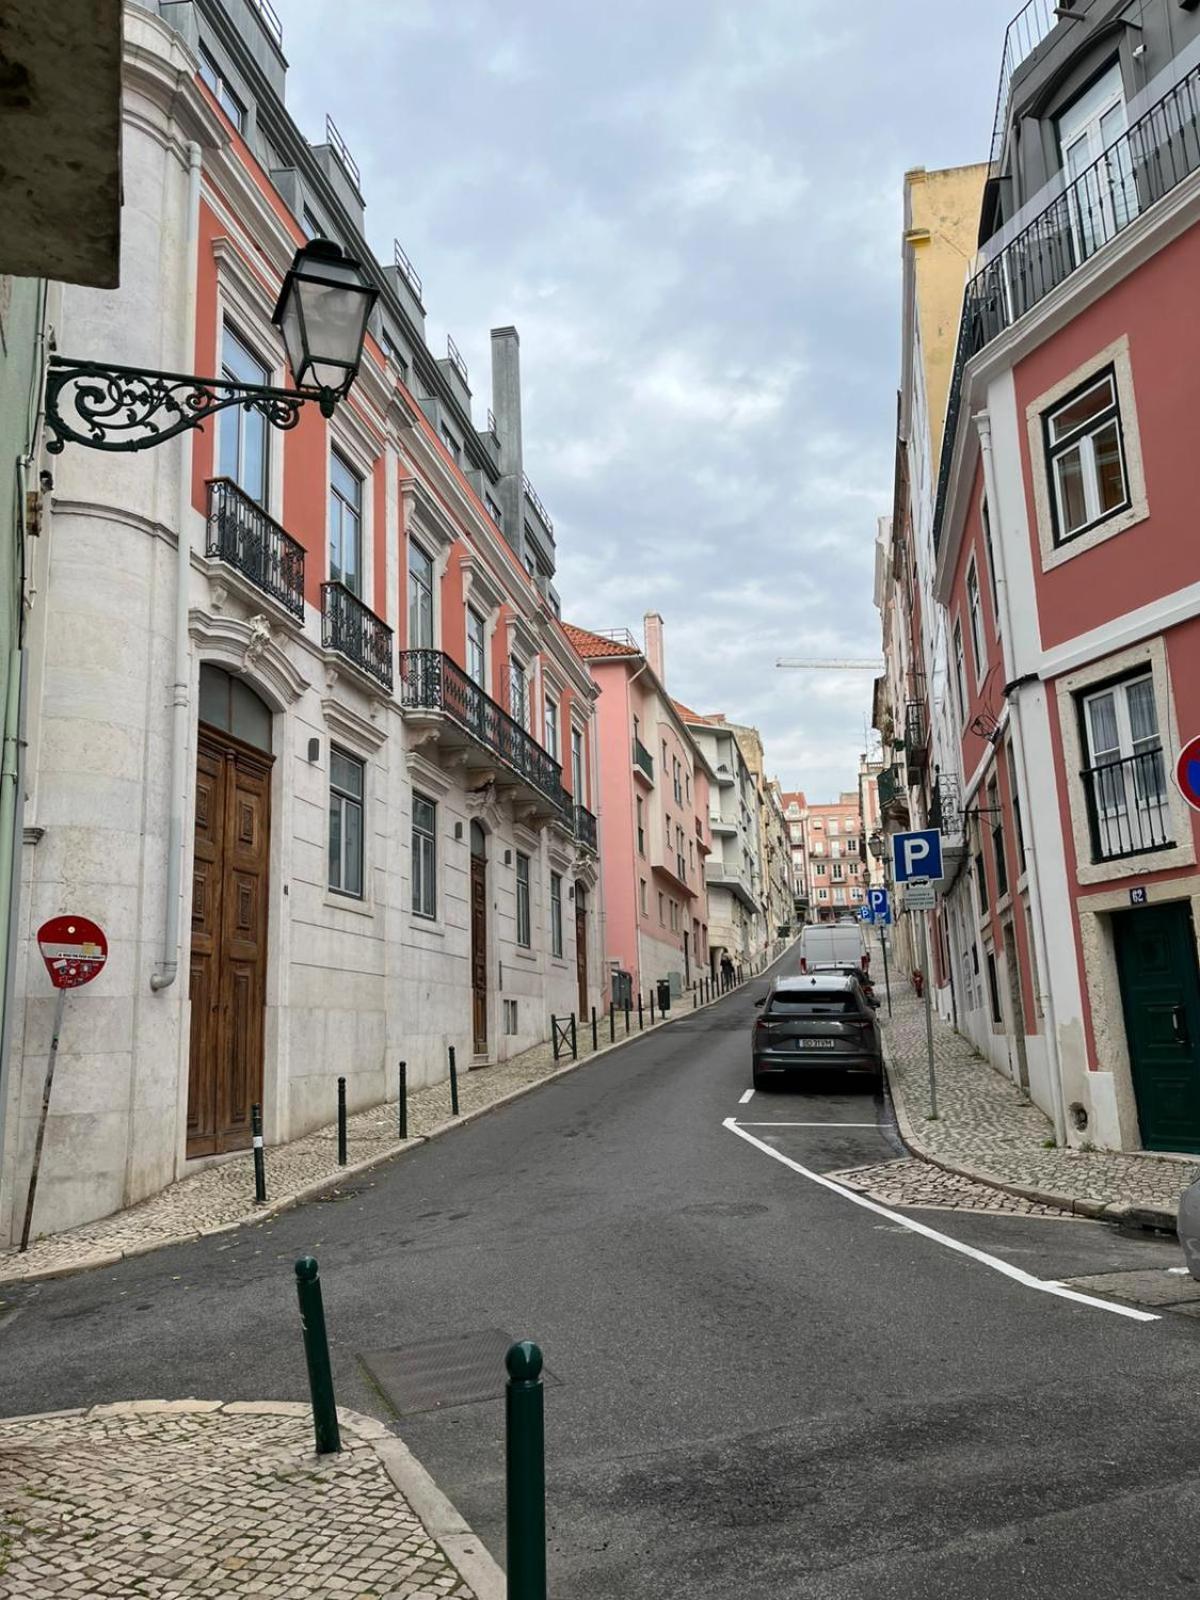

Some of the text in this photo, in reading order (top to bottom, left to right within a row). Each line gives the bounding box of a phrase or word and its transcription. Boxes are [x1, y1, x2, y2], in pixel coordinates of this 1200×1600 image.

[904, 838, 930, 875] P
[871, 891, 883, 912] P
[1132, 889, 1144, 903] 62
